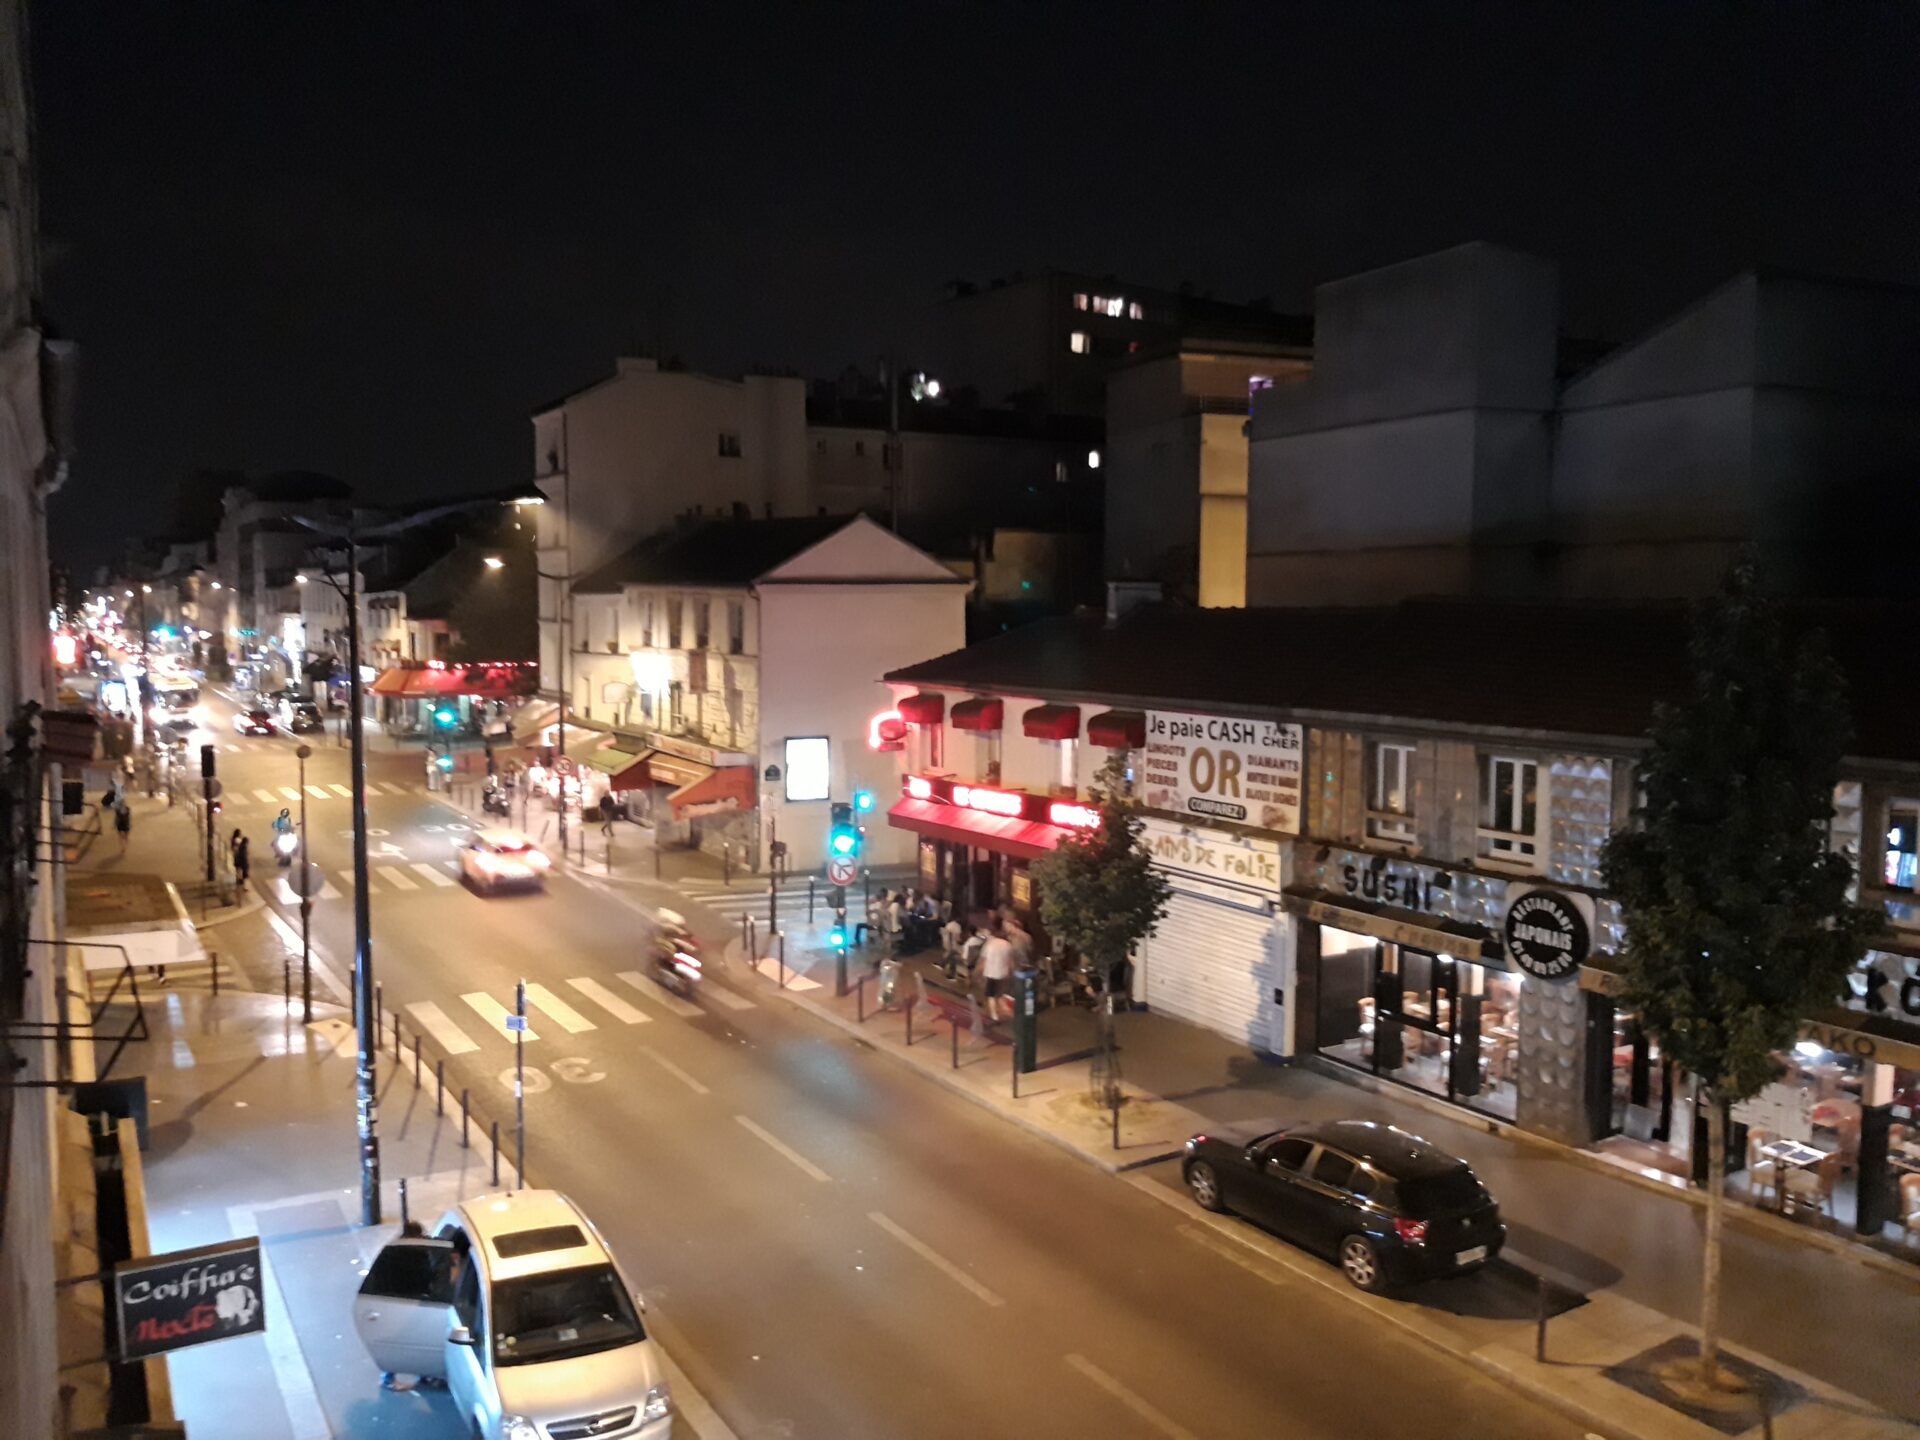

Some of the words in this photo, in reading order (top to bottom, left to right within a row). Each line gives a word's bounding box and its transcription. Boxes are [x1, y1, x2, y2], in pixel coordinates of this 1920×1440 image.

[1150, 714, 1166, 735] Je
[1170, 717, 1204, 741] paie
[1207, 720, 1256, 745] CASH
[1262, 736, 1300, 750] CHER
[1189, 746, 1242, 799] OR
[1247, 755, 1299, 772] DIAMANTS
[1194, 844, 1217, 868] DE
[1343, 865, 1433, 911] SUSHI
[1511, 897, 1574, 931] RESTAURANT
[1512, 921, 1573, 951] JAPONAIS
